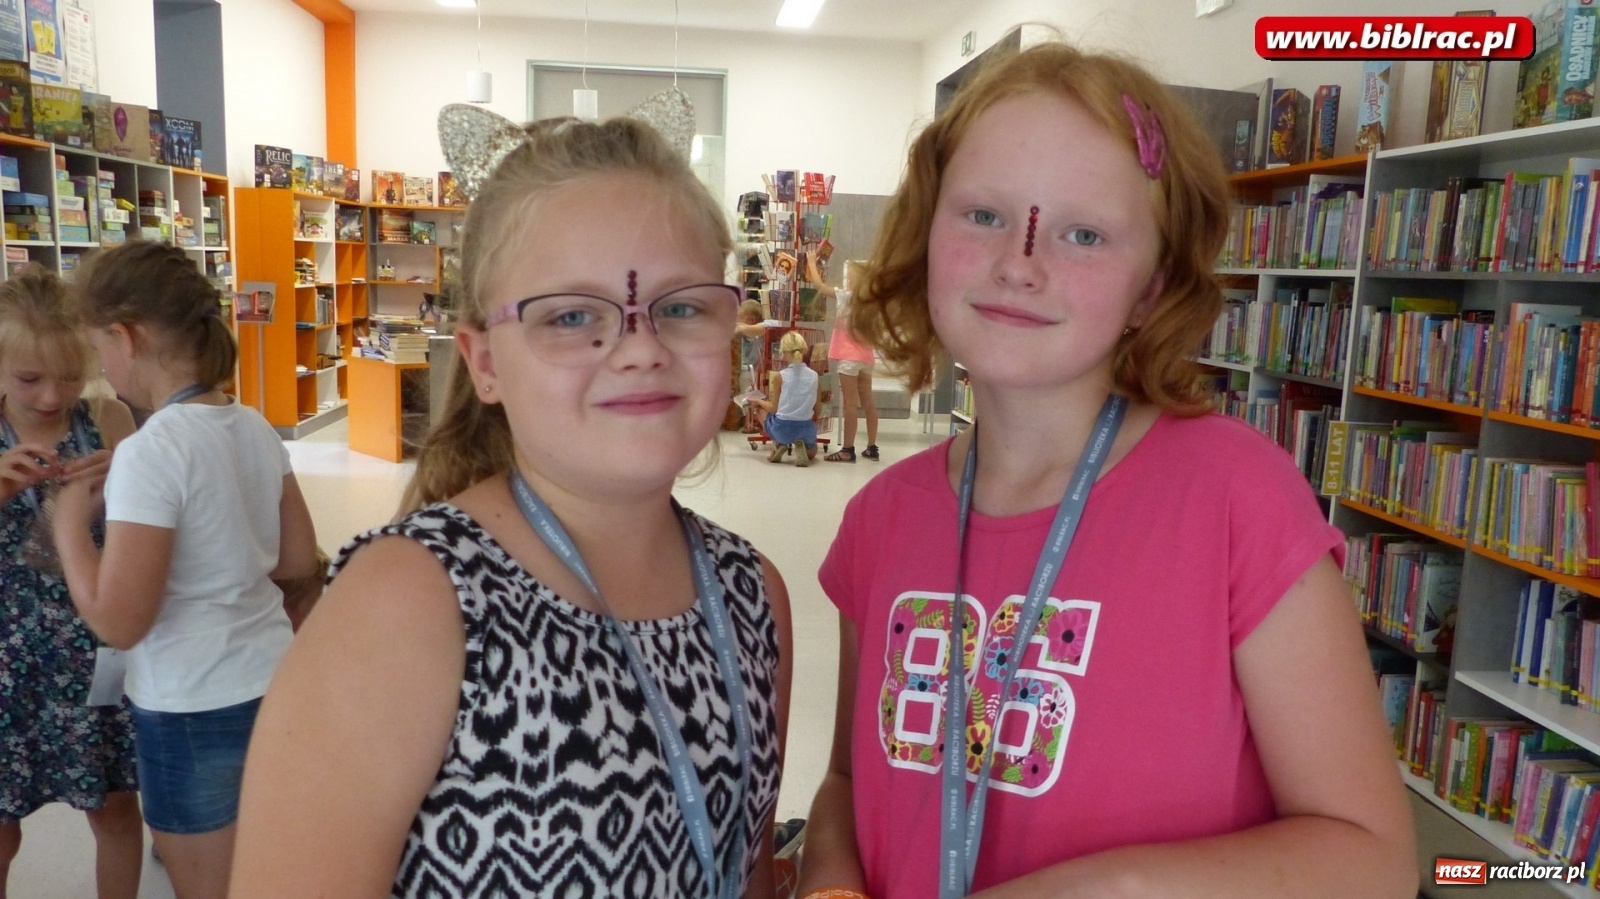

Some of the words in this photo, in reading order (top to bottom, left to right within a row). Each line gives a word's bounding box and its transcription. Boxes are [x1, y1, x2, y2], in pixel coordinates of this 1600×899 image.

[265, 149, 291, 166] RELIC
[1087, 426, 1110, 464] BIBLIOTEKA
[1331, 427, 1344, 456] LAT
[1327, 461, 1340, 490] 8-11
[708, 596, 726, 639] RACIBORZU
[1012, 617, 1032, 663] BIBLIOTEKA
[1031, 562, 1053, 610] RACIBORZU
[878, 590, 1101, 797] 86
[952, 675, 961, 718] BIBLIOTEKA
[658, 711, 681, 758] BIBLIOTEKA
[951, 727, 961, 777] RACIBORZU
